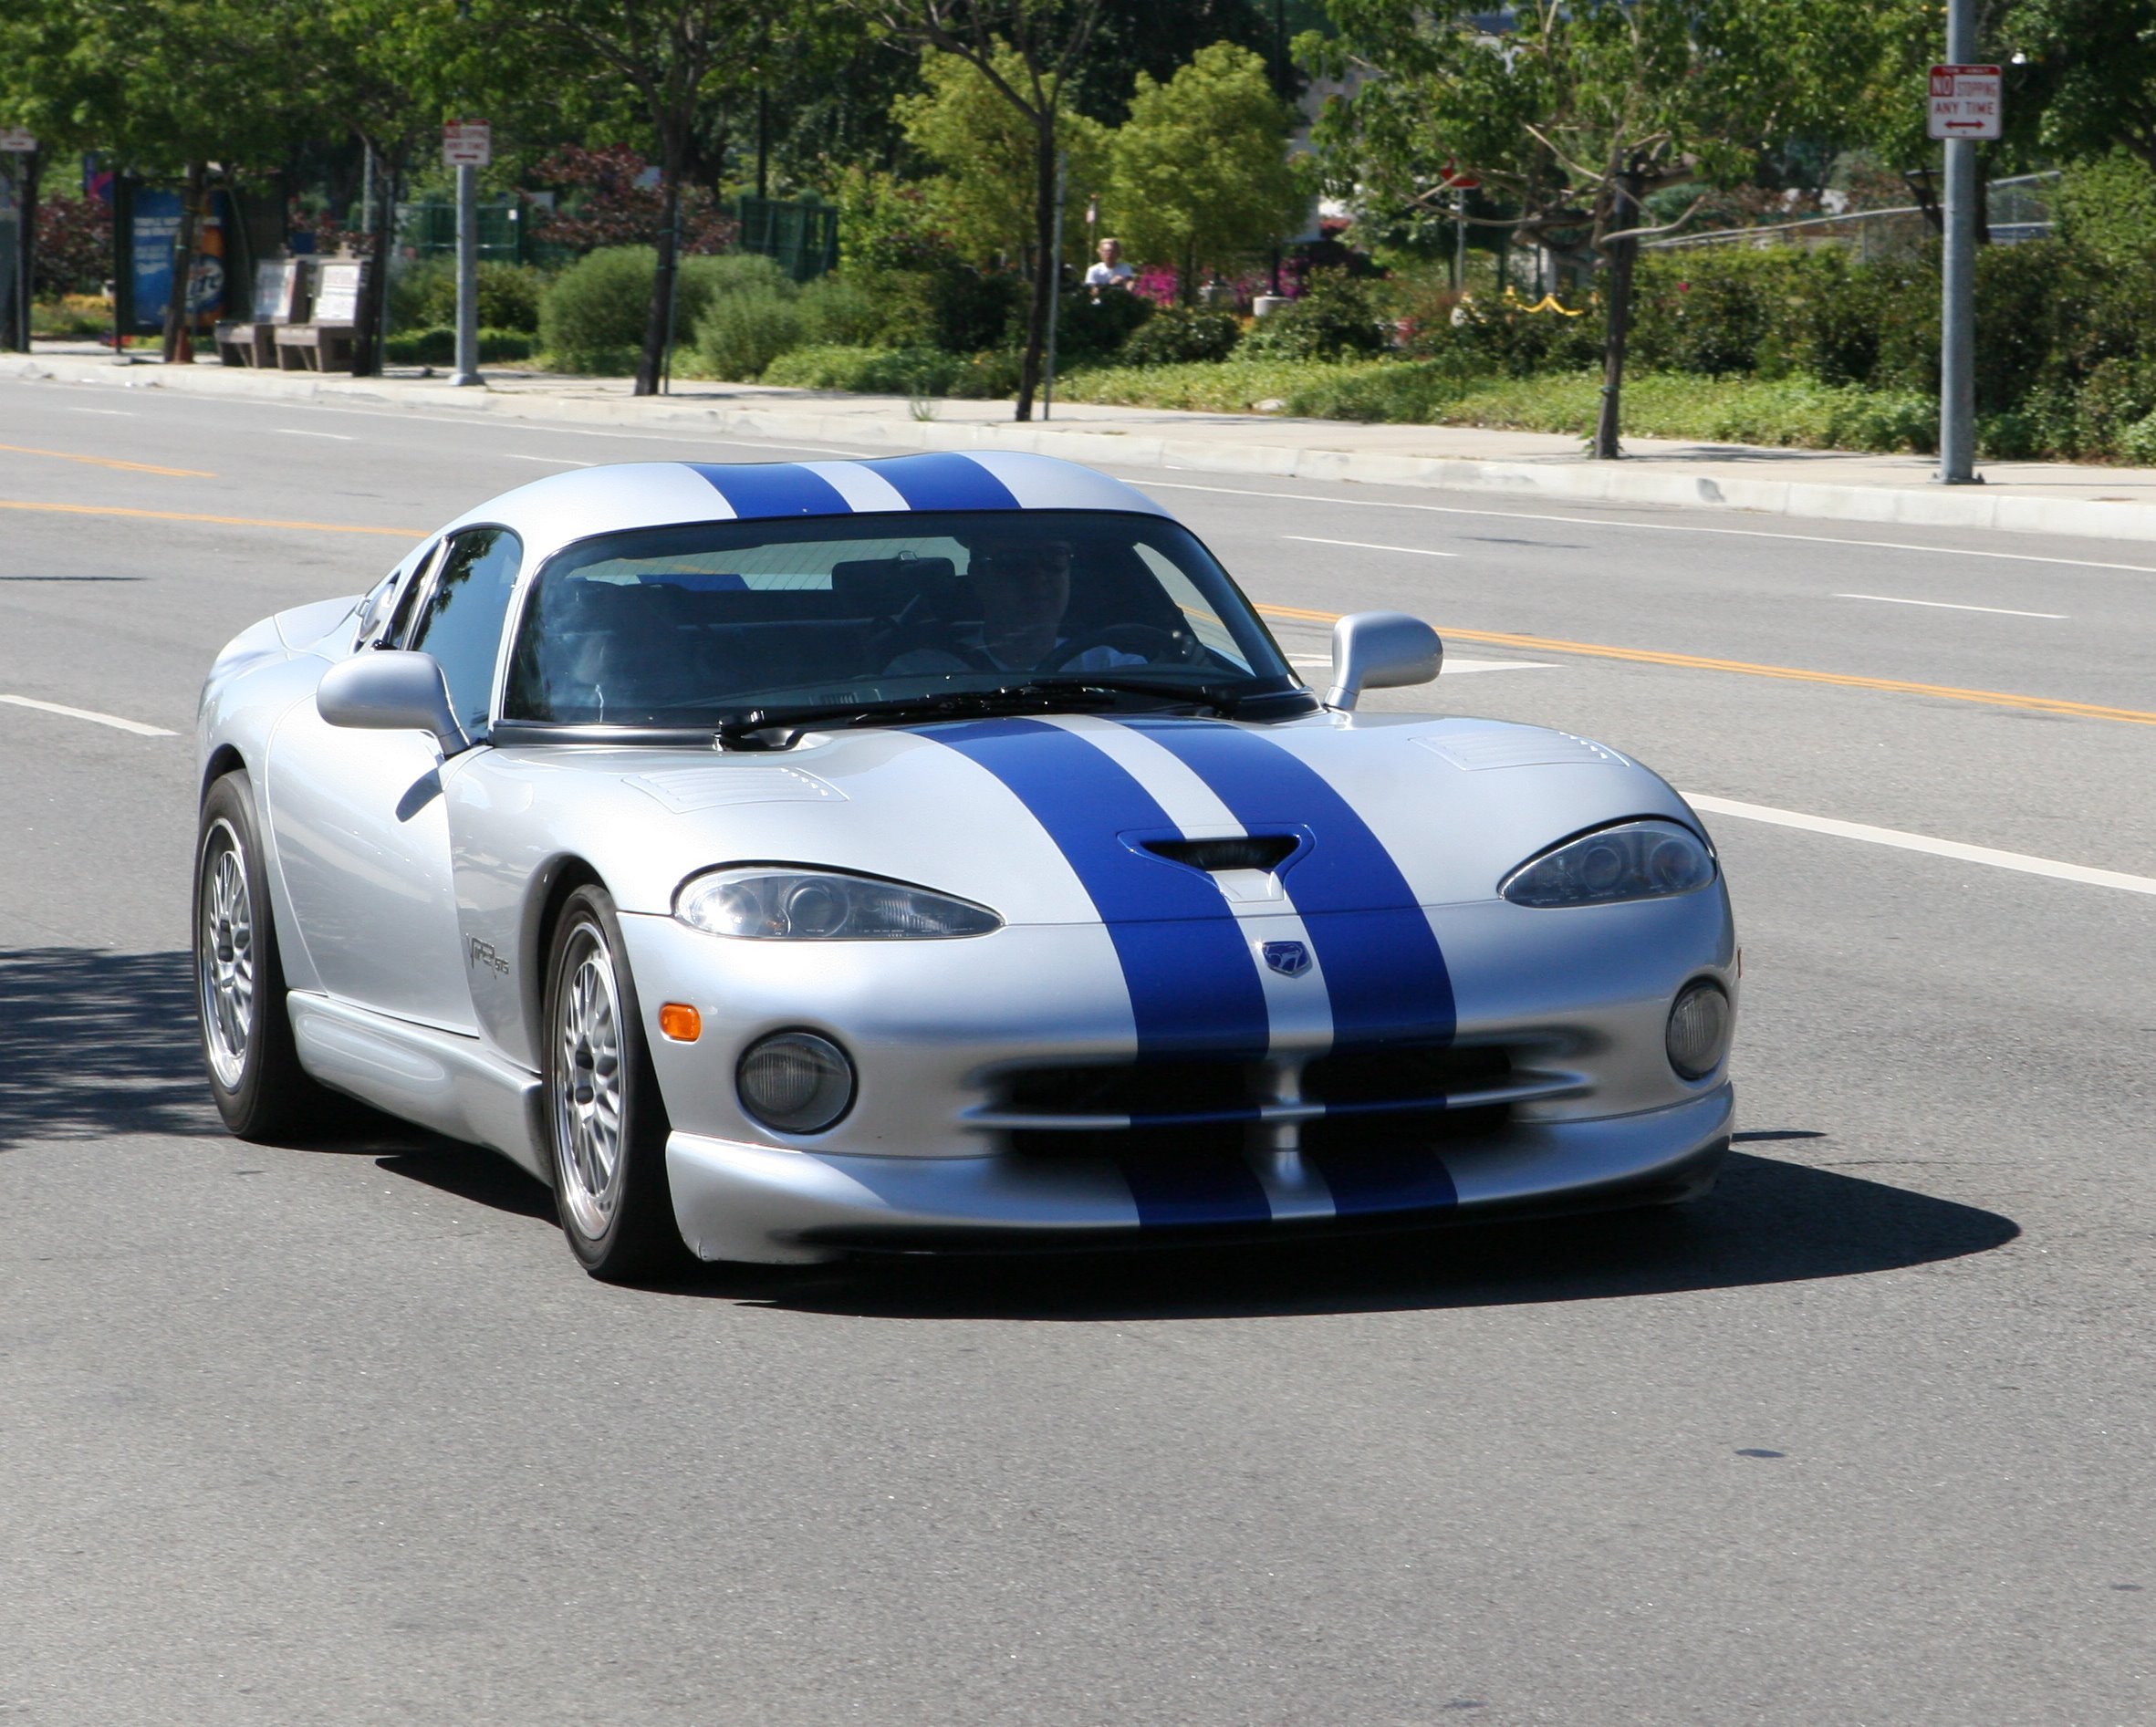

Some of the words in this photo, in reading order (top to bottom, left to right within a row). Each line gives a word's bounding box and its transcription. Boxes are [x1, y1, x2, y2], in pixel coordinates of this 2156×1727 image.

[1932, 76, 1953, 96] NO
[1935, 102, 1959, 115] ANY
[1965, 102, 1995, 115] TIME
